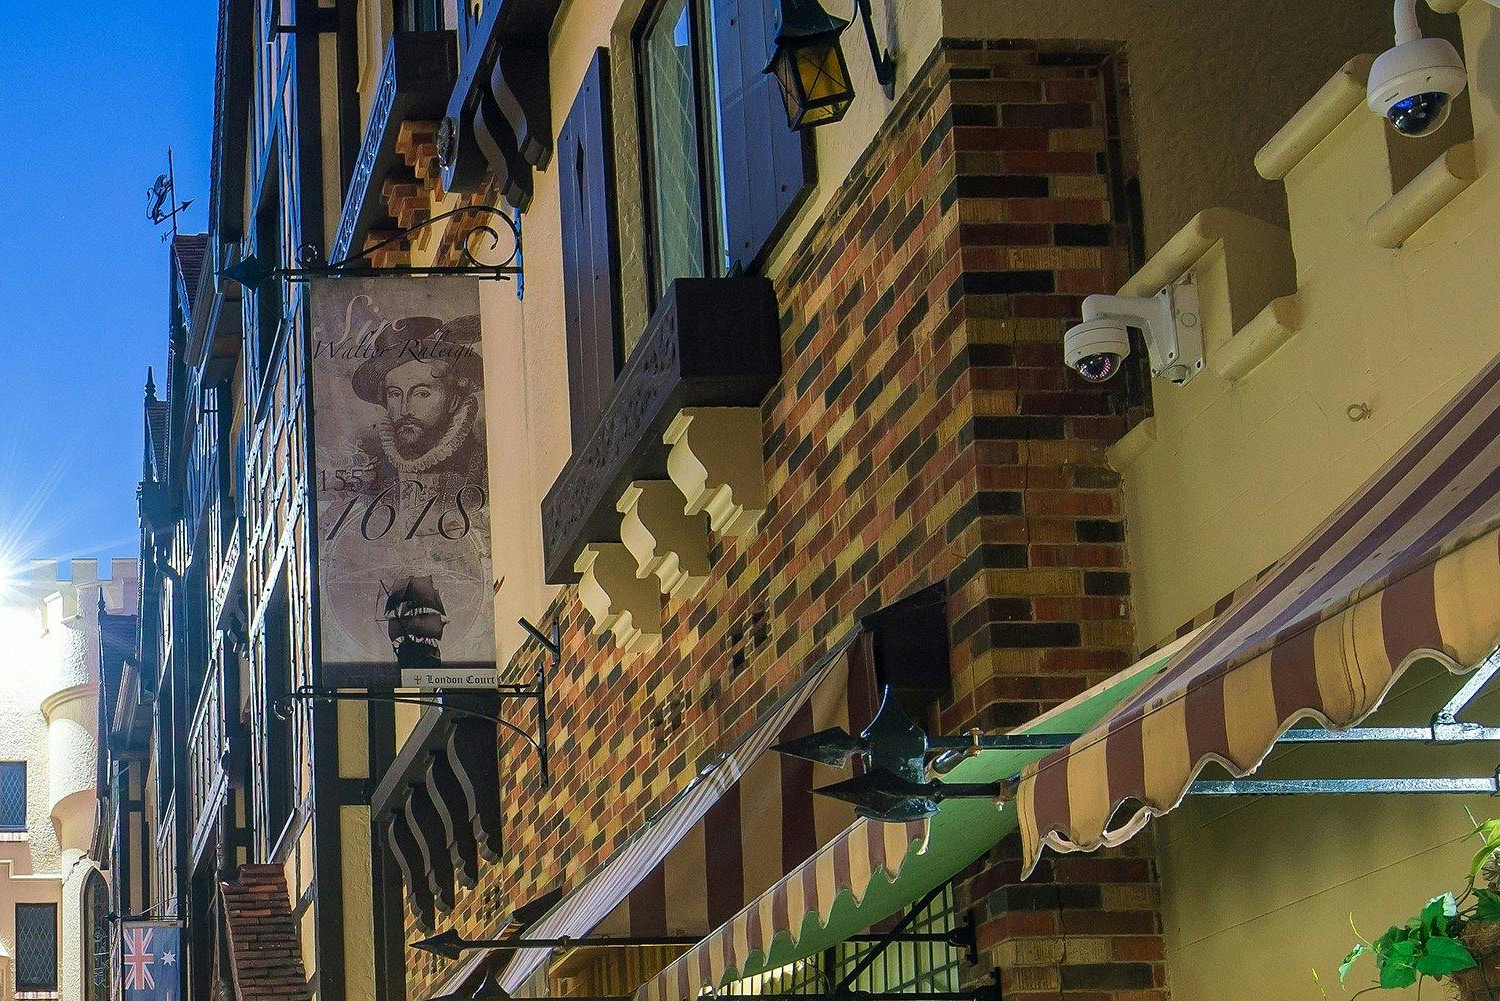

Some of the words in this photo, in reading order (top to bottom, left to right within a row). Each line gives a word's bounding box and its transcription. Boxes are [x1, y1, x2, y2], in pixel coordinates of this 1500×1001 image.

[313, 330, 394, 361] Walter
[389, 329, 476, 378] Raleigh
[325, 479, 487, 541] 1618
[426, 674, 464, 685] London
[465, 674, 496, 685] Court
